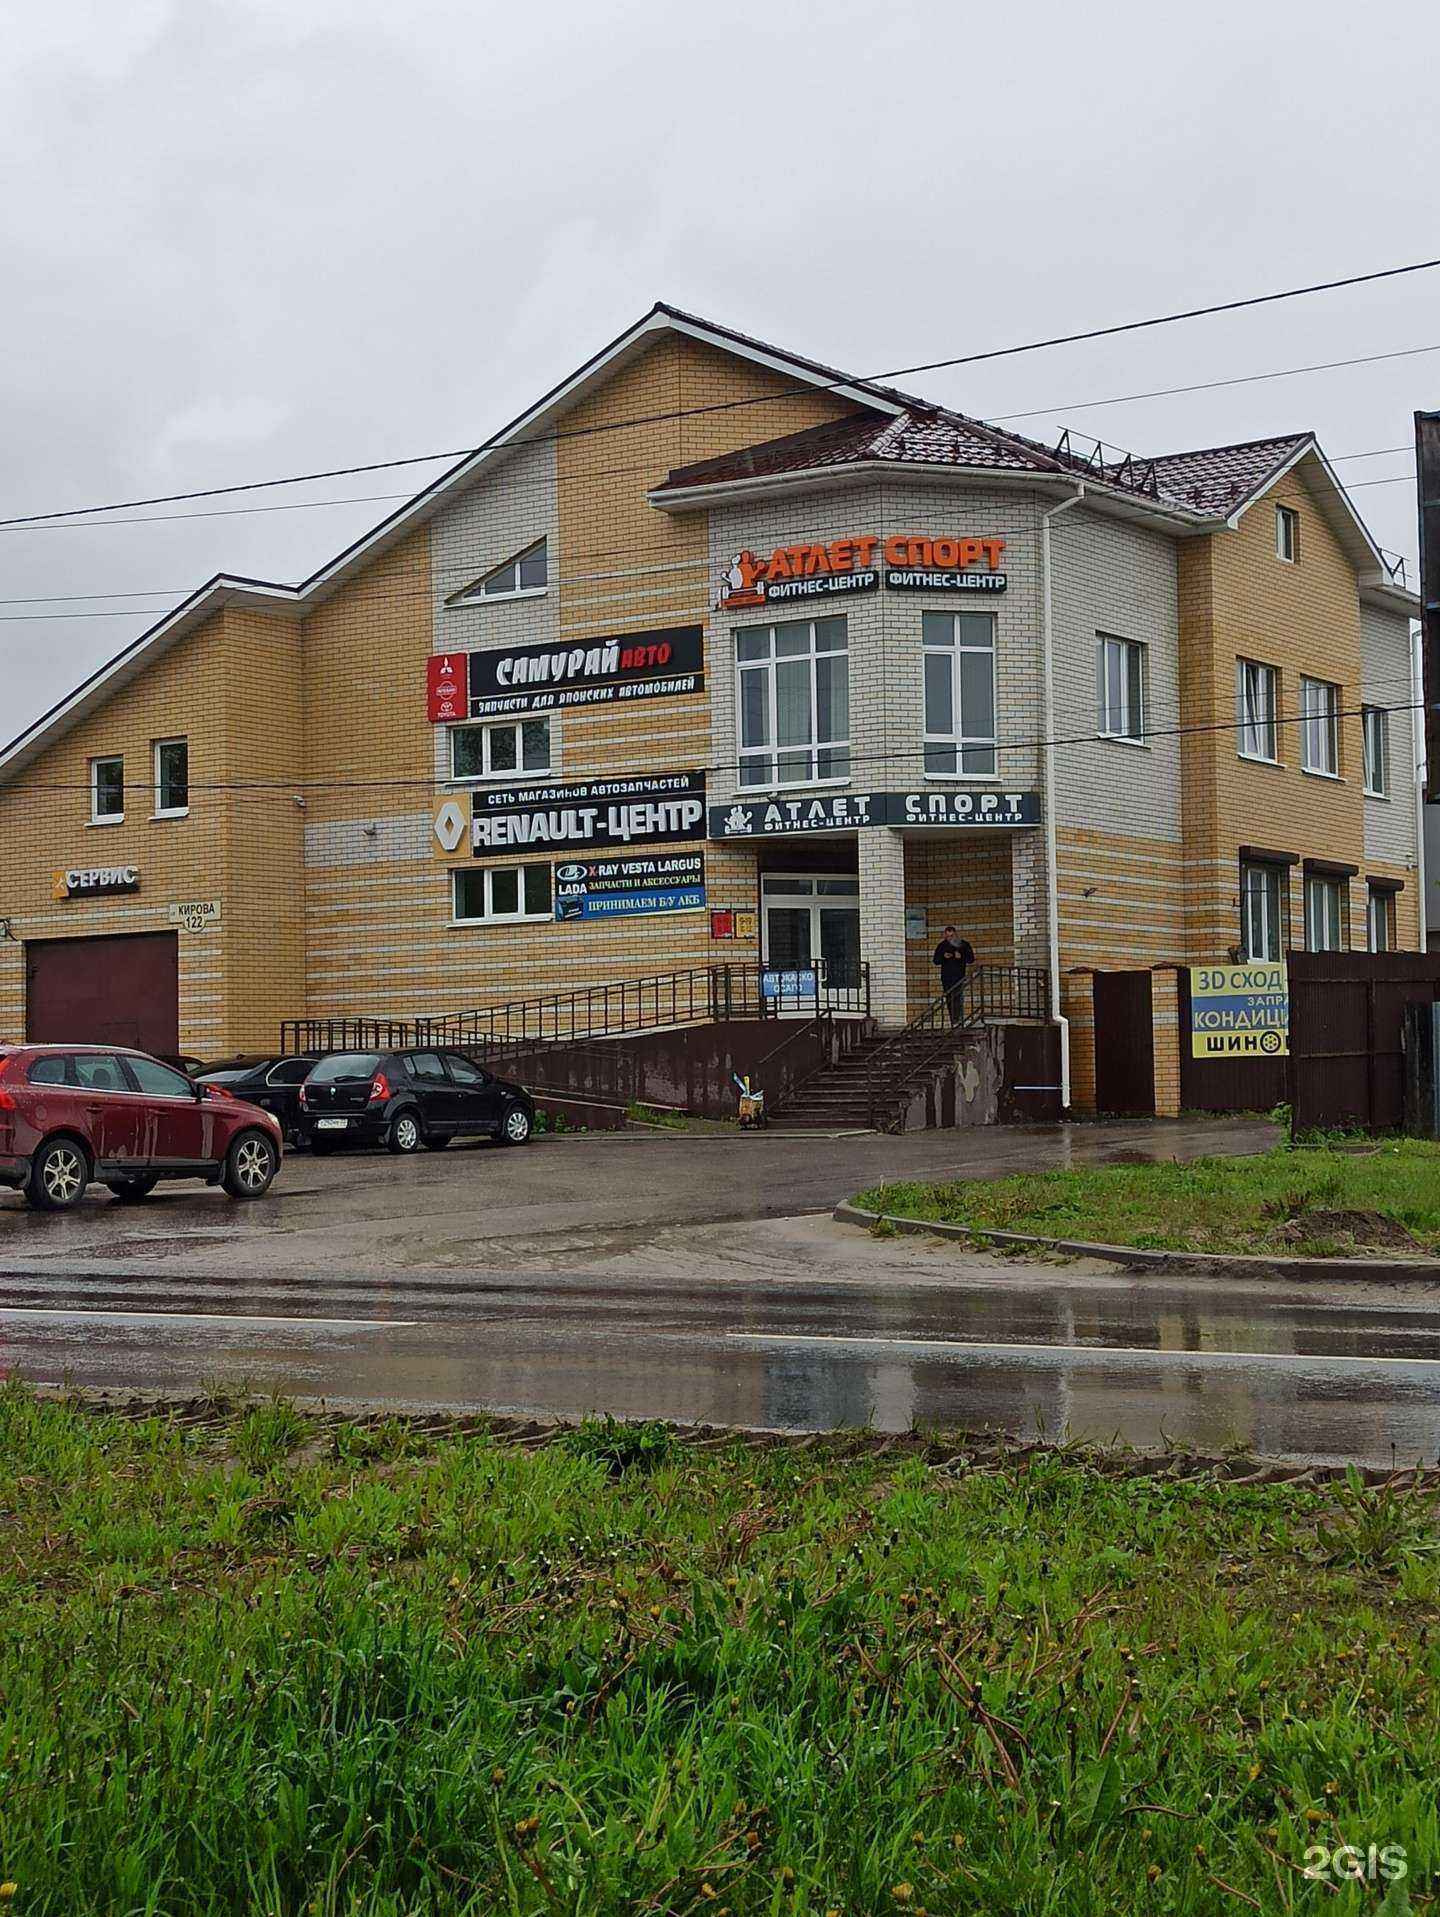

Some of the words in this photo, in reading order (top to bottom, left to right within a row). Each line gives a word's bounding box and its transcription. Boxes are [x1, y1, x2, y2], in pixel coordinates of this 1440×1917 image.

[767, 535, 878, 580] АТЛЕТ
[884, 535, 1007, 570] СПОРТ
[768, 572, 875, 599] ФИТНЕС-ЦЕНТР
[889, 572, 1006, 590] ФИТНЕС-ЦЕНТР
[496, 639, 621, 687] САМУРАЙ
[478, 697, 528, 714] ЗАПЧАСТИ
[532, 694, 555, 709] ДЛЯ
[559, 688, 614, 705] ЯПОНСКИХ
[618, 676, 695, 697] АВТОМОБИЛЕЙ
[488, 793, 515, 805] СЕТЬ
[518, 787, 588, 802] МАГАЗИНОВ
[590, 776, 689, 796] АВТОЗАПЧАСТЕЙ
[764, 796, 871, 822] АТЛЕТ
[905, 794, 1022, 813] СПОРТ
[473, 799, 702, 847] RENAULT-ЦЕНТР
[764, 815, 870, 831] ФИТНЕС-ЦЕНТР
[906, 812, 1022, 822] ФИТНЕС-ЦЕНТР
[622, 861, 656, 875] VESTA
[658, 858, 701, 872] LARGUS
[66, 865, 139, 889] СЕРВИС
[588, 879, 632, 890] ЗАПЧАСТИ
[642, 874, 700, 888] АКСЕССУАРЫ
[558, 883, 587, 895] LADA
[178, 903, 215, 915] КИРОВА
[588, 897, 657, 911] ПРИНИМАЕМ
[659, 895, 676, 907] Б/У
[678, 894, 700, 906] АКБ
[186, 916, 203, 928] 122
[1198, 971, 1225, 990] 3D
